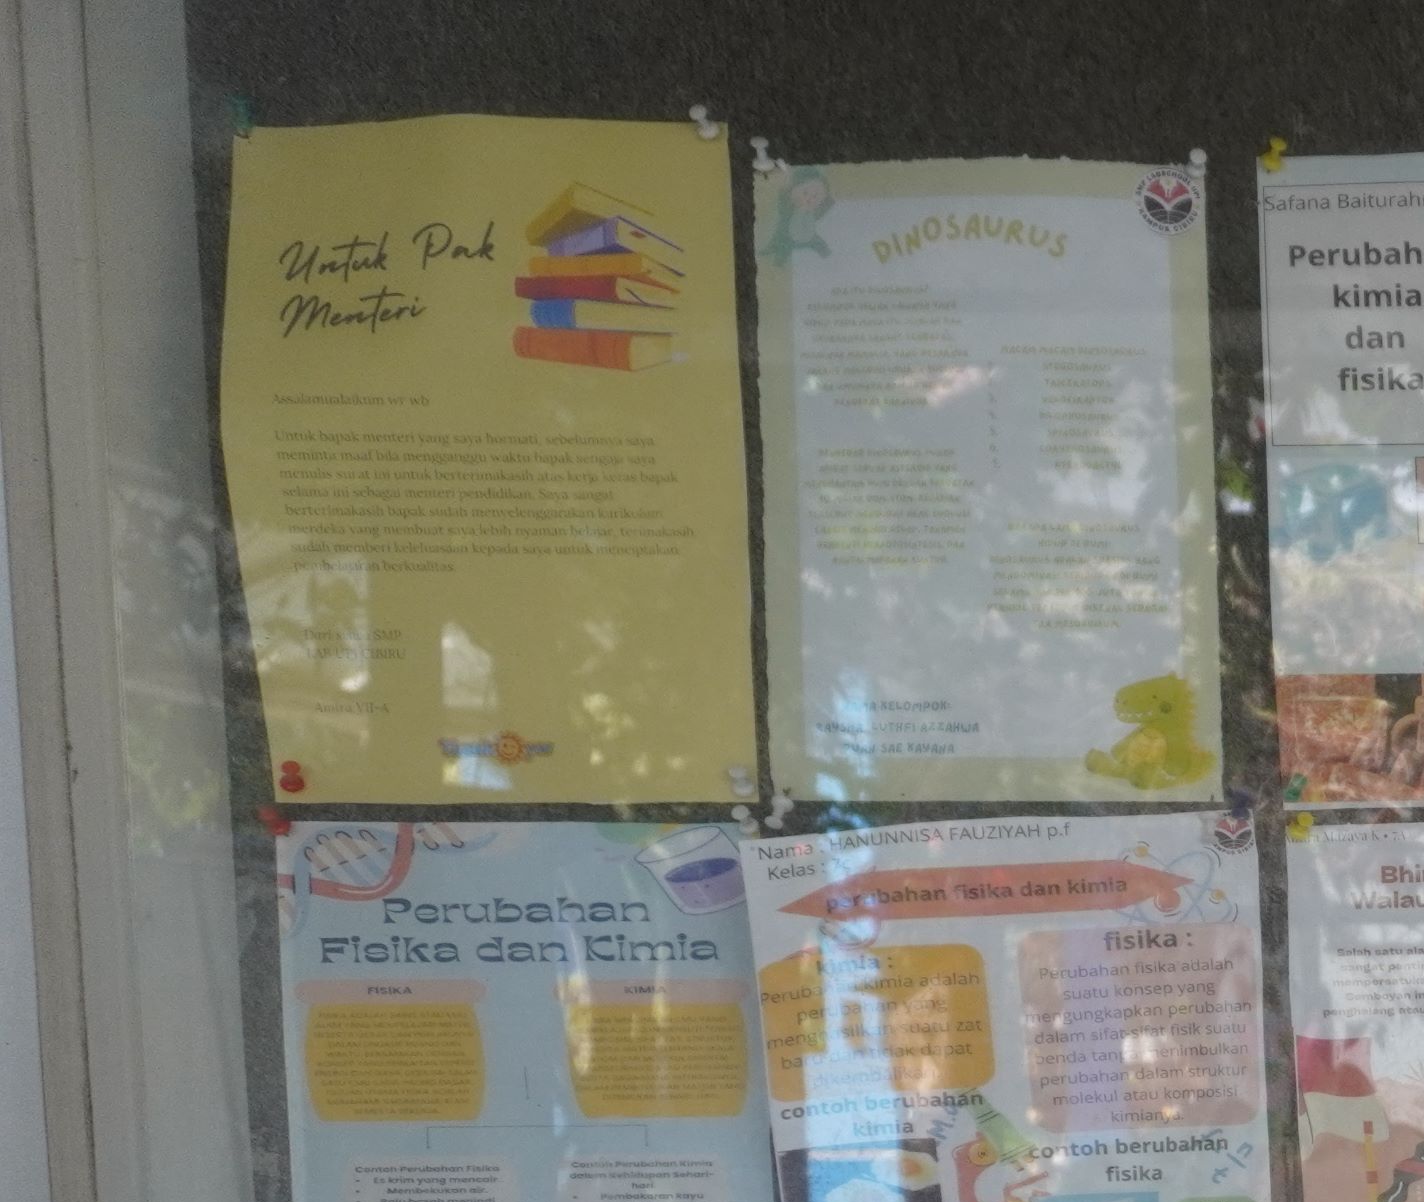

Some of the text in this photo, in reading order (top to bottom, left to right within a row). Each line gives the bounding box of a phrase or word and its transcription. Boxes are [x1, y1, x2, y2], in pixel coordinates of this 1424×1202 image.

[1264, 194, 1331, 213] Safana
[872, 212, 1069, 264] DINOSAURUS
[280, 220, 495, 284] Untuk Pak
[1332, 283, 1423, 309] kimia
[280, 285, 428, 338] Menteri
[1345, 325, 1406, 350] dan
[1337, 366, 1424, 392] fisika
[274, 431, 483, 447] Untuk bapak menteri yang saya
[758, 822, 1071, 862] Nama HANUNNISA FAUZIYAH p.f
[1019, 876, 1128, 897] dan kimia
[382, 897, 651, 925] Perubahan
[319, 933, 721, 964] Fisika dan Kimia
[1103, 929, 1181, 953] fisika
[1038, 957, 1235, 983] Perubahan fisika adalah
[1062, 981, 1216, 1002] suatu konsep yang
[1115, 1135, 1230, 1155] berubahan
[1105, 1164, 1163, 1184] fisika
